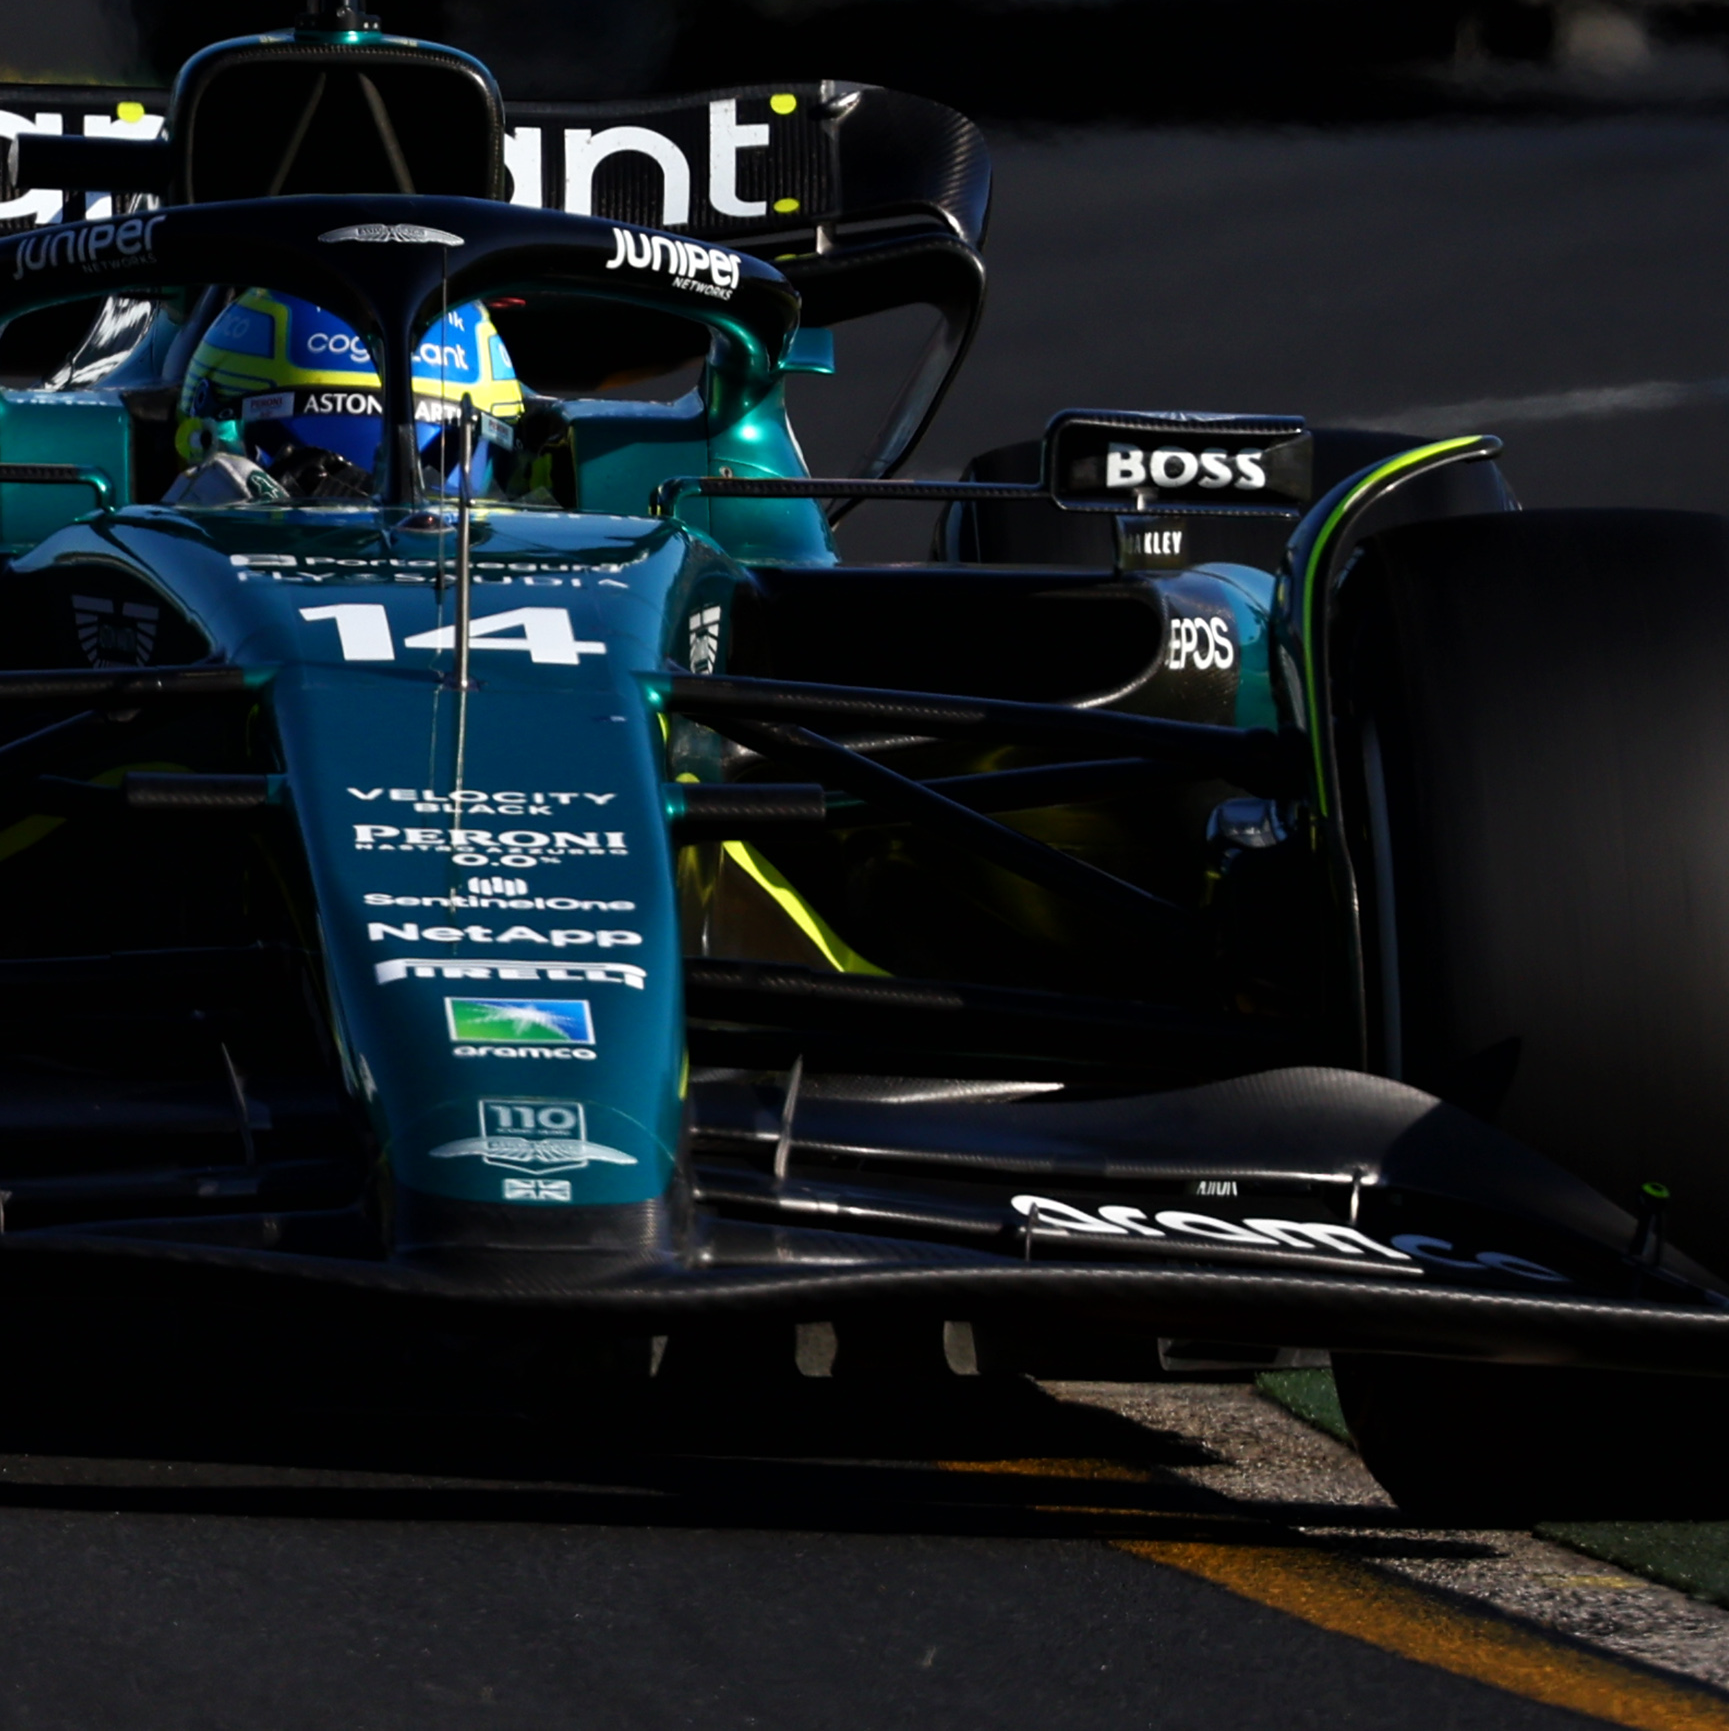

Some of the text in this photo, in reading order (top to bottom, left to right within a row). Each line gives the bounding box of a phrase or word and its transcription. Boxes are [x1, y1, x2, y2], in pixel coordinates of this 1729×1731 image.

[81, 252, 157, 275] NETWORKS
[672, 276, 733, 302] NETWORKS
[303, 392, 384, 416] ASTON
[1106, 441, 1266, 491] BOSS
[298, 603, 608, 666] 14
[1166, 616, 1234, 670] EPOS
[347, 787, 618, 806] VELOCITY
[413, 802, 554, 817] BLACK
[352, 823, 628, 849] PERONI
[363, 892, 636, 912] SentinelOne
[367, 921, 644, 948] NetApp
[374, 957, 648, 991] PIRELLI
[452, 1044, 597, 1061] aramco
[489, 1104, 576, 1131] 110
[1010, 1193, 1572, 1282] aramco
